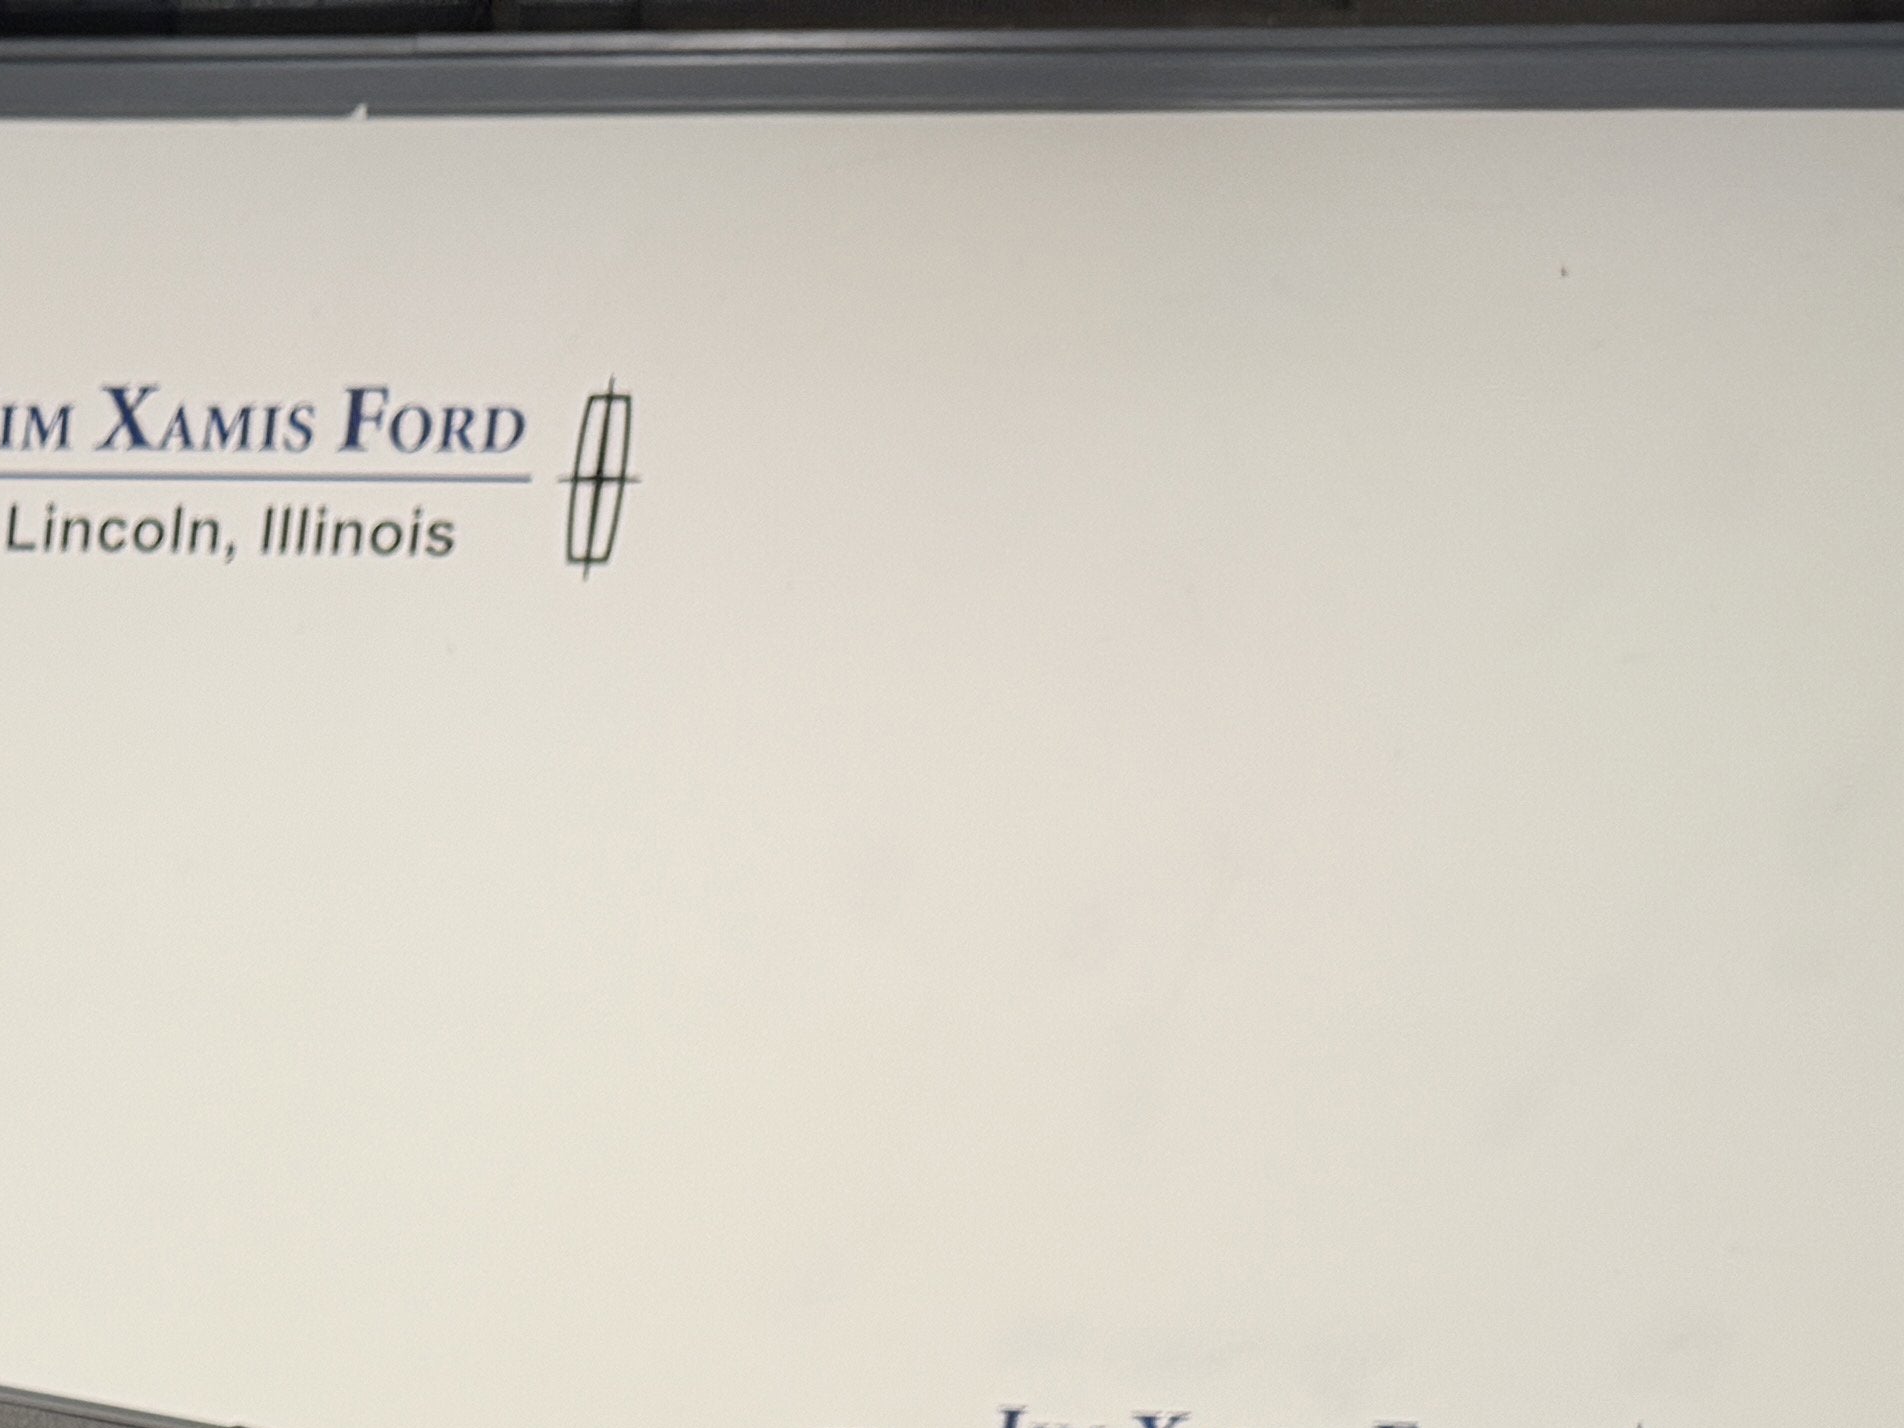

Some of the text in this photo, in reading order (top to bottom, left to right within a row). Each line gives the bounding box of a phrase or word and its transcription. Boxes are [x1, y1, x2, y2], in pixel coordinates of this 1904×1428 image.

[95, 383, 316, 453] XAMIS
[337, 385, 526, 454] FORD
[5, 502, 456, 564] Lincoln, Illinois
